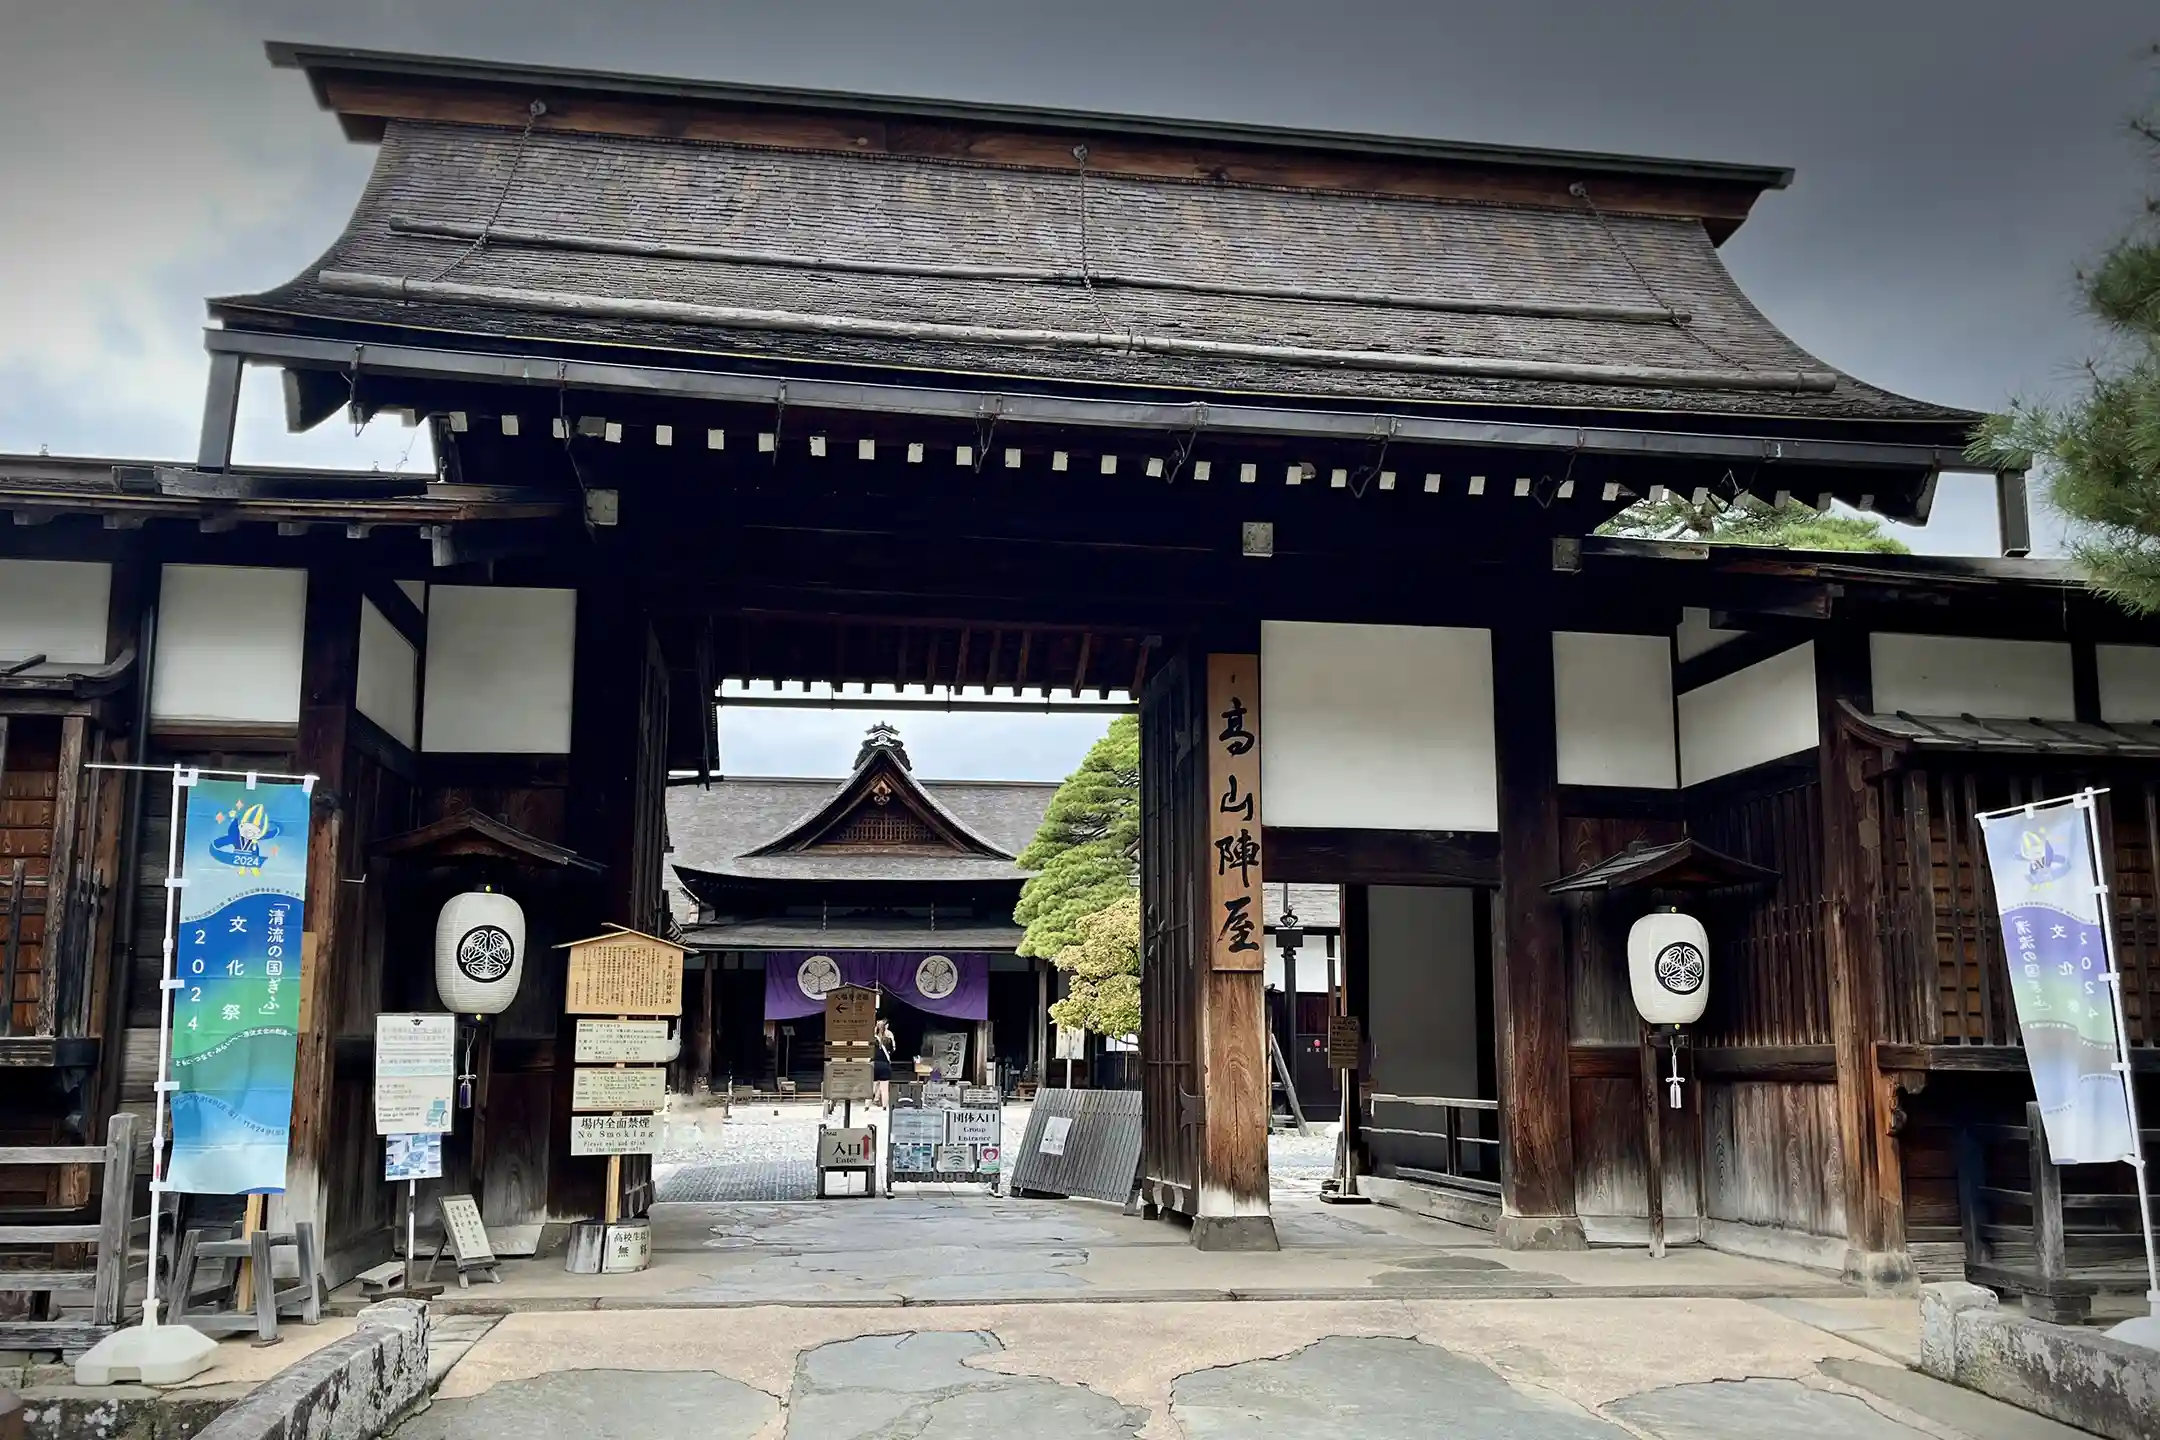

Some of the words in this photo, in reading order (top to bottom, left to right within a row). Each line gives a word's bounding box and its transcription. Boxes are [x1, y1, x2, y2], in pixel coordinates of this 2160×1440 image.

[1215, 697, 1260, 953] 高山陣屋
[233, 856, 260, 866] 2024
[258, 902, 291, 1015] 「清流の国ぎふ」
[222, 916, 248, 1020] 文化祭
[187, 929, 206, 1030] 2024
[581, 1117, 651, 1130] 場内全面禁煙
[953, 1112, 996, 1123] 団体入口
[577, 1130, 593, 1139] No
[599, 1130, 654, 1139] Smoking
[832, 1141, 861, 1156] 入口
